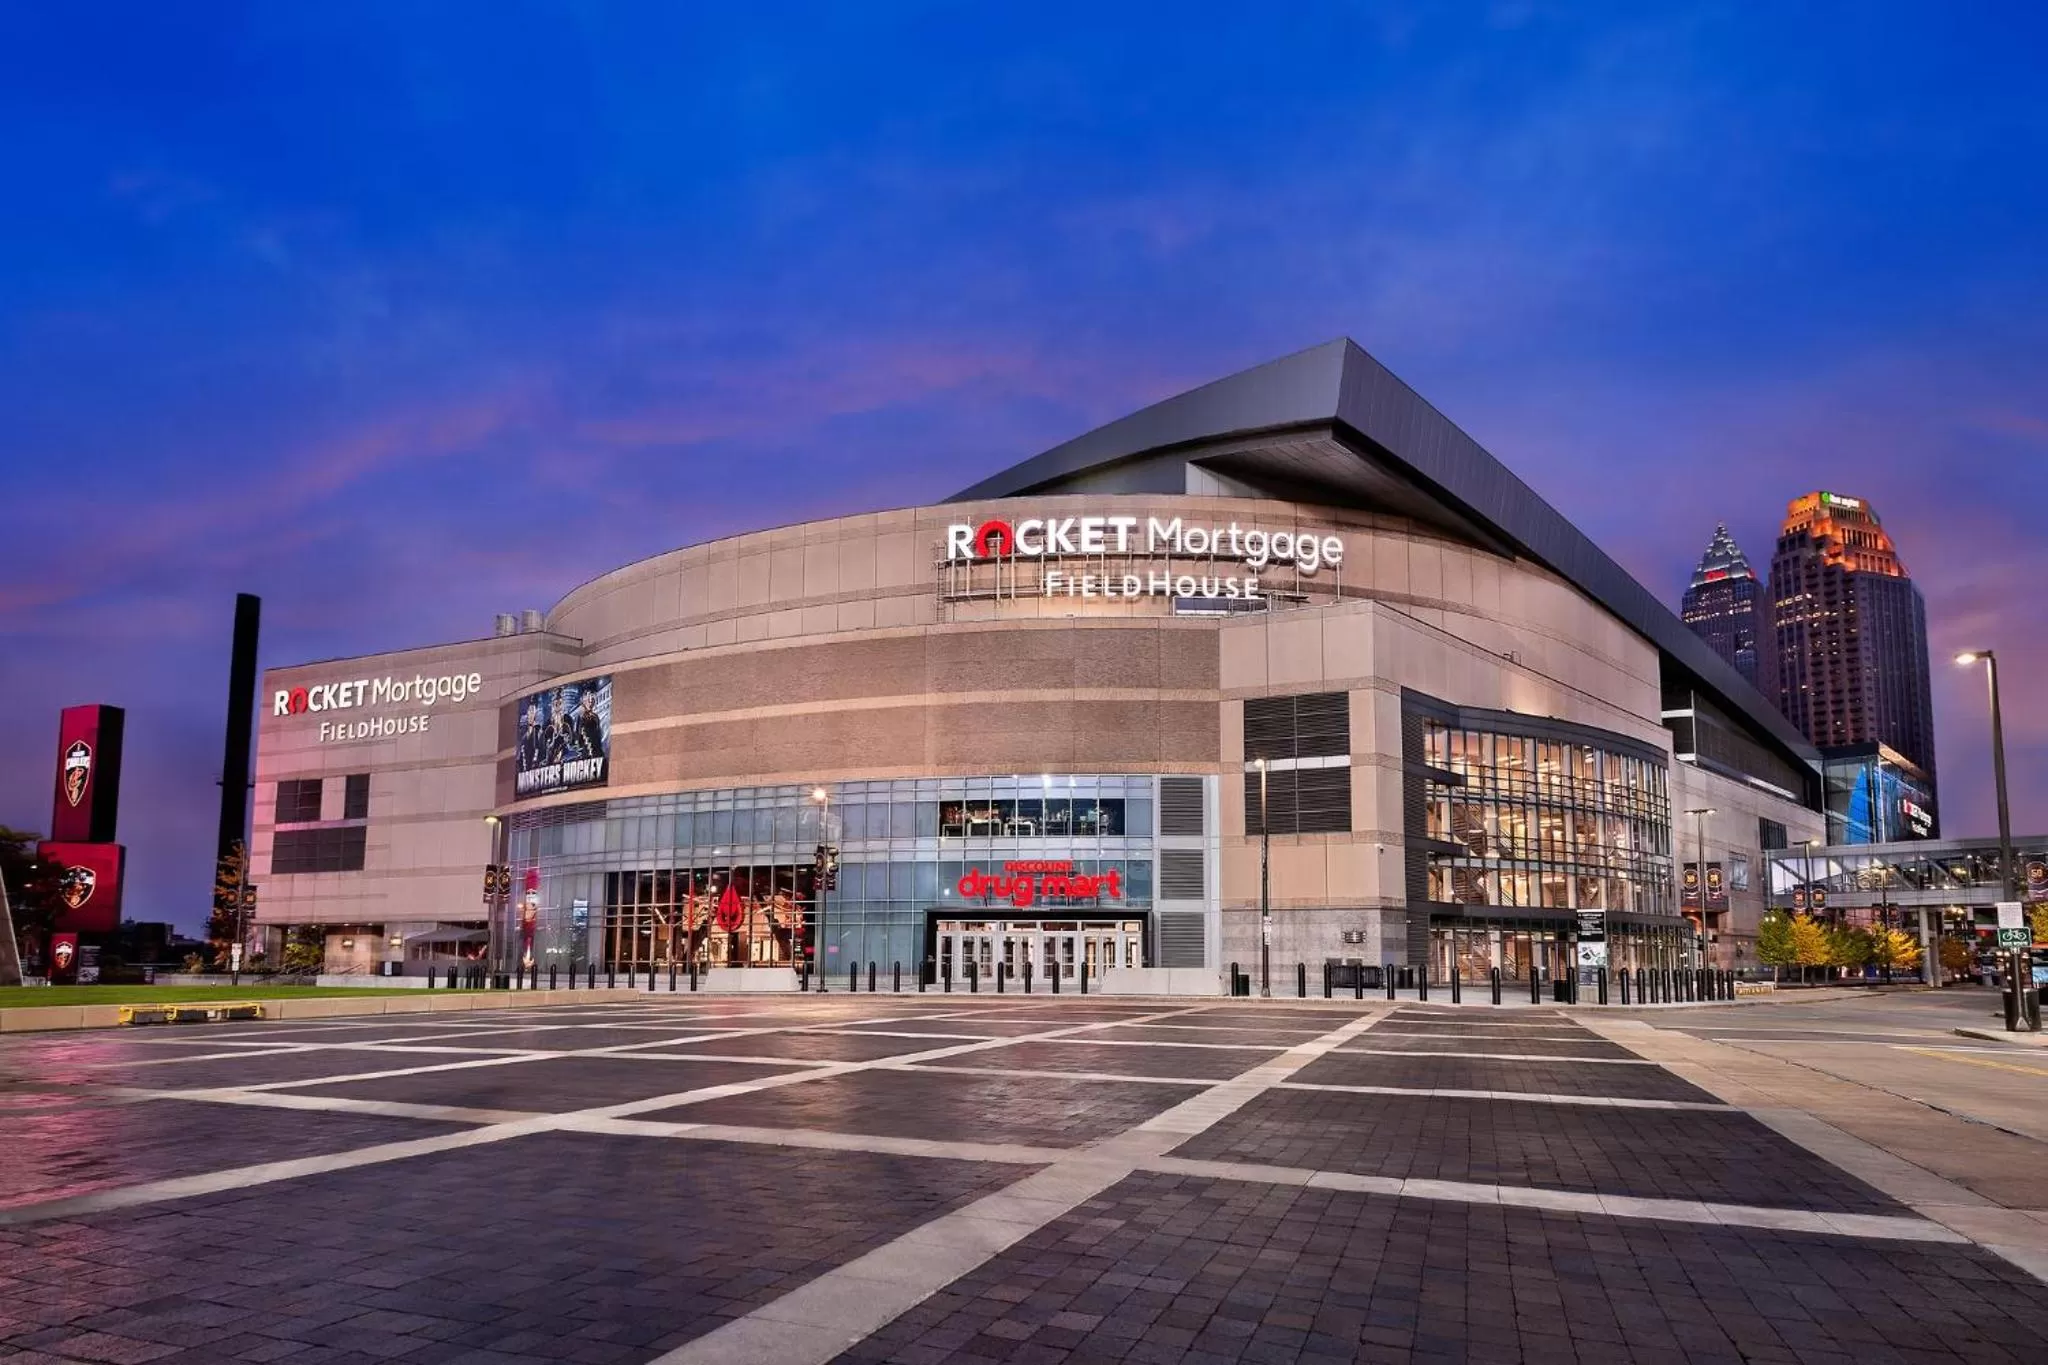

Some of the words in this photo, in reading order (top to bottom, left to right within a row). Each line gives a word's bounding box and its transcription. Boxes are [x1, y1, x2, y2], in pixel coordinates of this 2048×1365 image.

[947, 516, 1137, 560] ROCKET
[1148, 516, 1345, 573] Mortgage
[274, 680, 369, 716] ROCKET
[372, 672, 482, 706] Mortgage
[517, 764, 561, 791] MONSTERS
[563, 757, 604, 784] HOCKEY
[1004, 860, 1074, 873] DISCOUNT
[957, 867, 1035, 907] drug
[1041, 867, 1122, 900] mart
